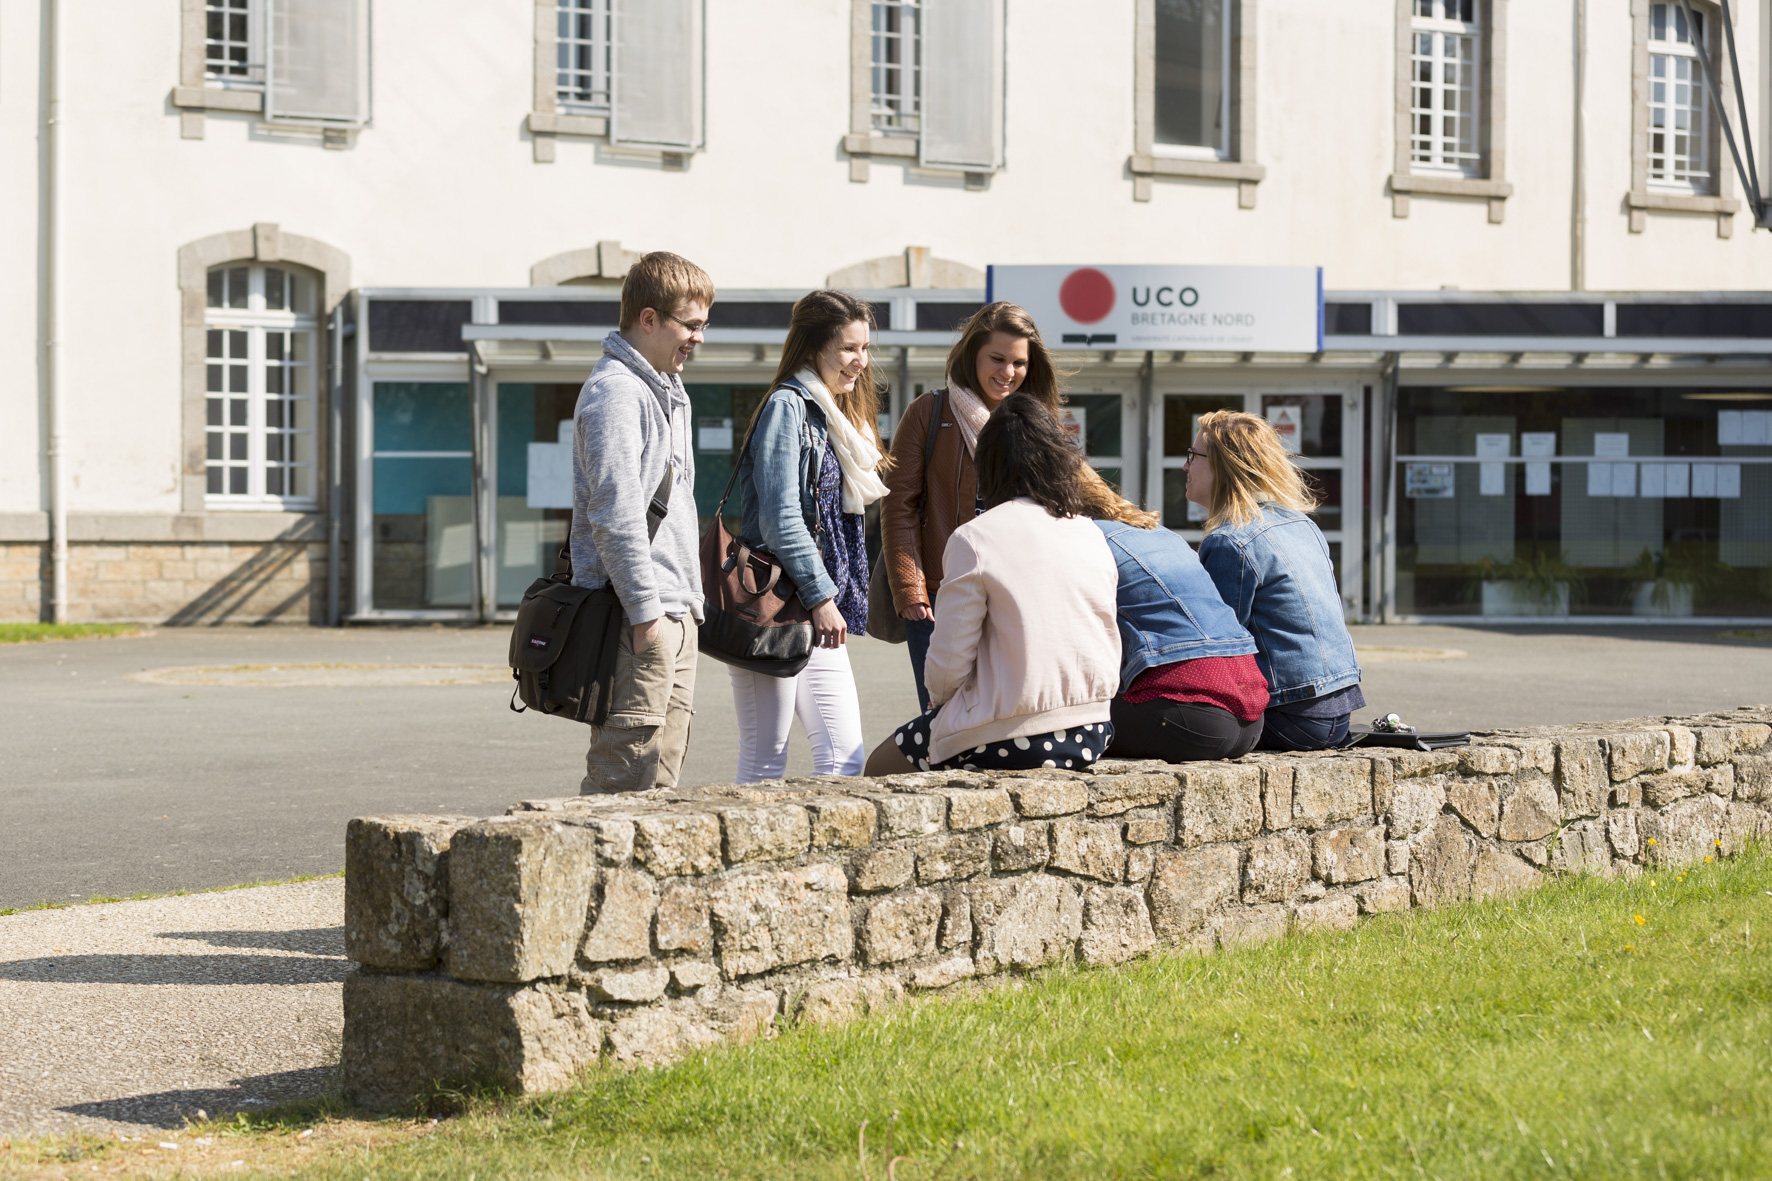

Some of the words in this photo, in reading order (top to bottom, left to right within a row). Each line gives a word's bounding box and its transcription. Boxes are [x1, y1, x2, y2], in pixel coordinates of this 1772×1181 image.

[1132, 287, 1198, 306] UCO
[1131, 313, 1207, 326] BRETAGNE
[1213, 313, 1255, 326] NORD
